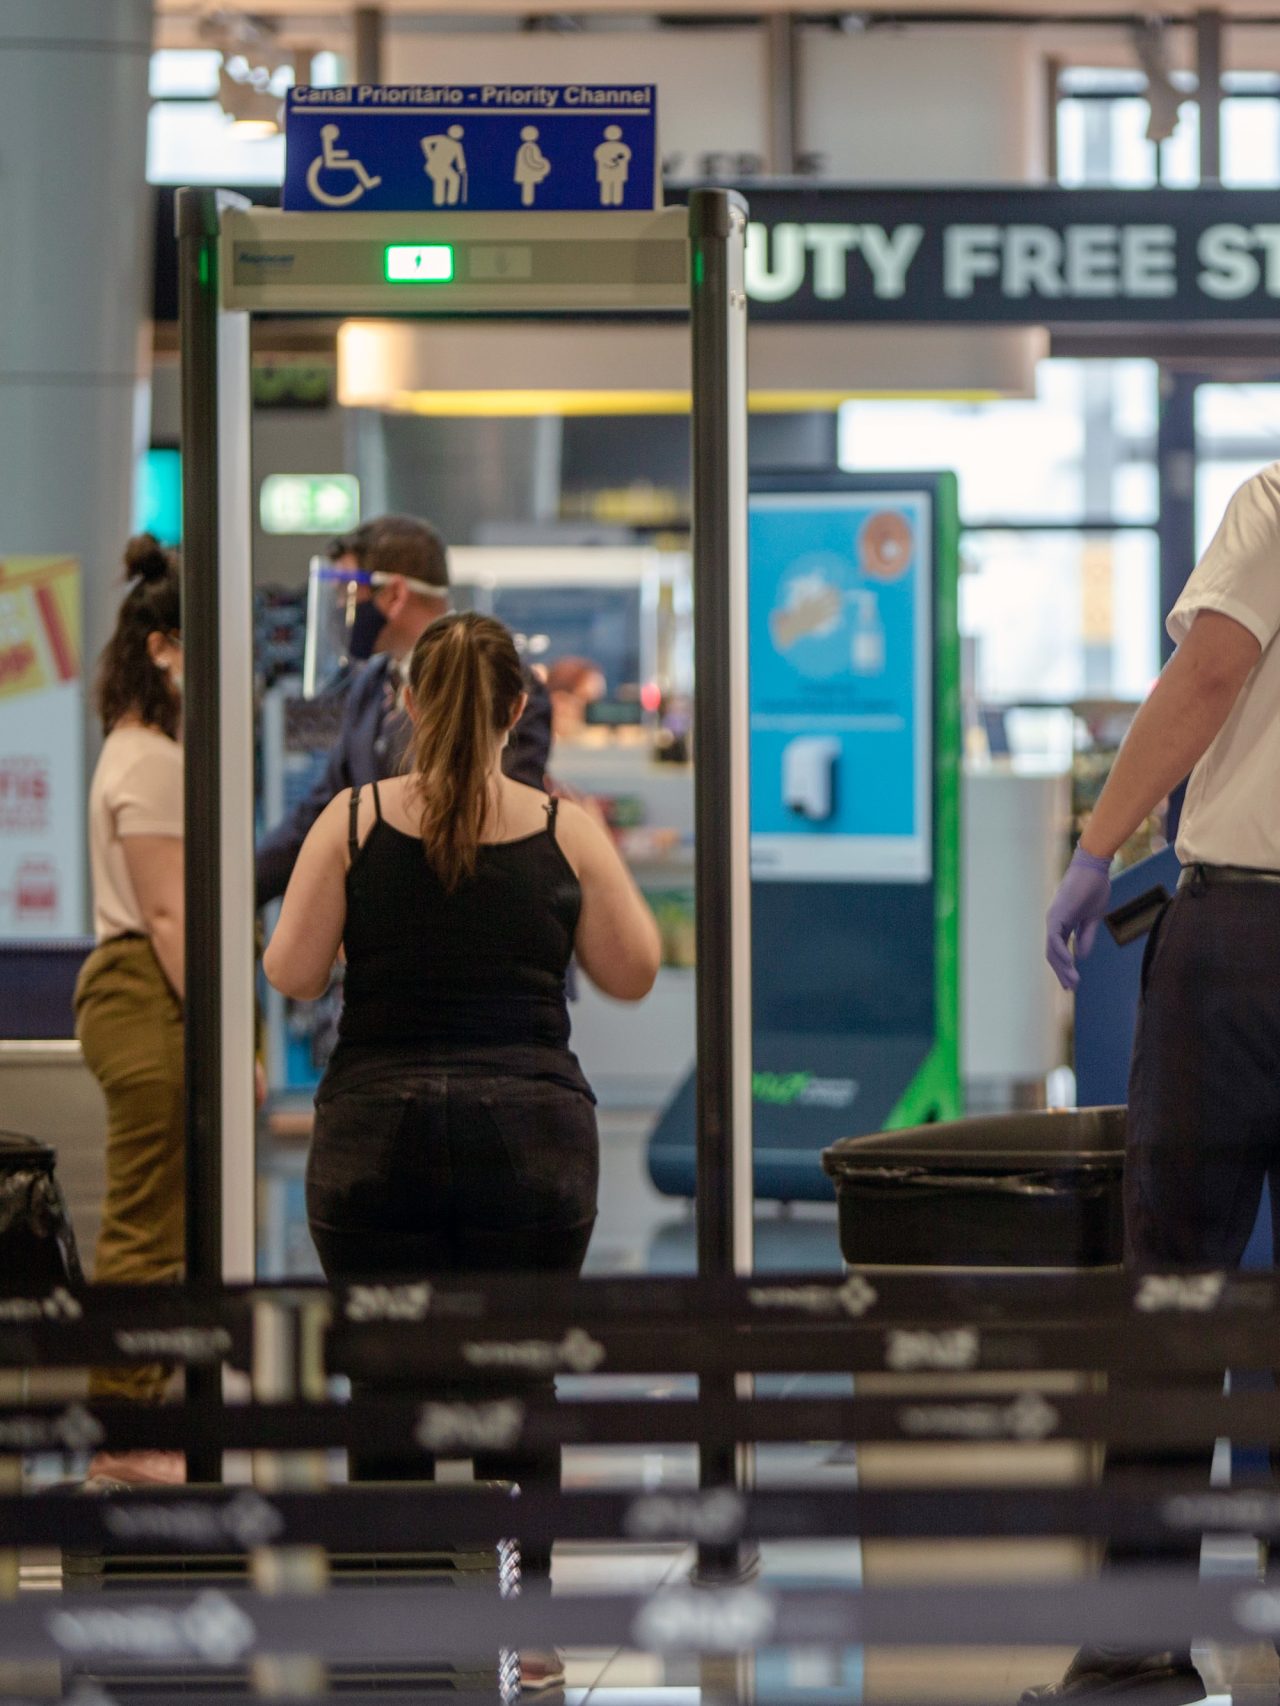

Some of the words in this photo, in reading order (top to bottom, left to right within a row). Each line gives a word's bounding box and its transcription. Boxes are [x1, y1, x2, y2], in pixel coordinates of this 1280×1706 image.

[291, 85, 350, 103] Canal
[357, 85, 464, 105] Prioritário
[482, 86, 560, 107] Priority
[563, 86, 651, 105] Channel
[744, 221, 924, 302] UTY
[942, 222, 1178, 300] FREE
